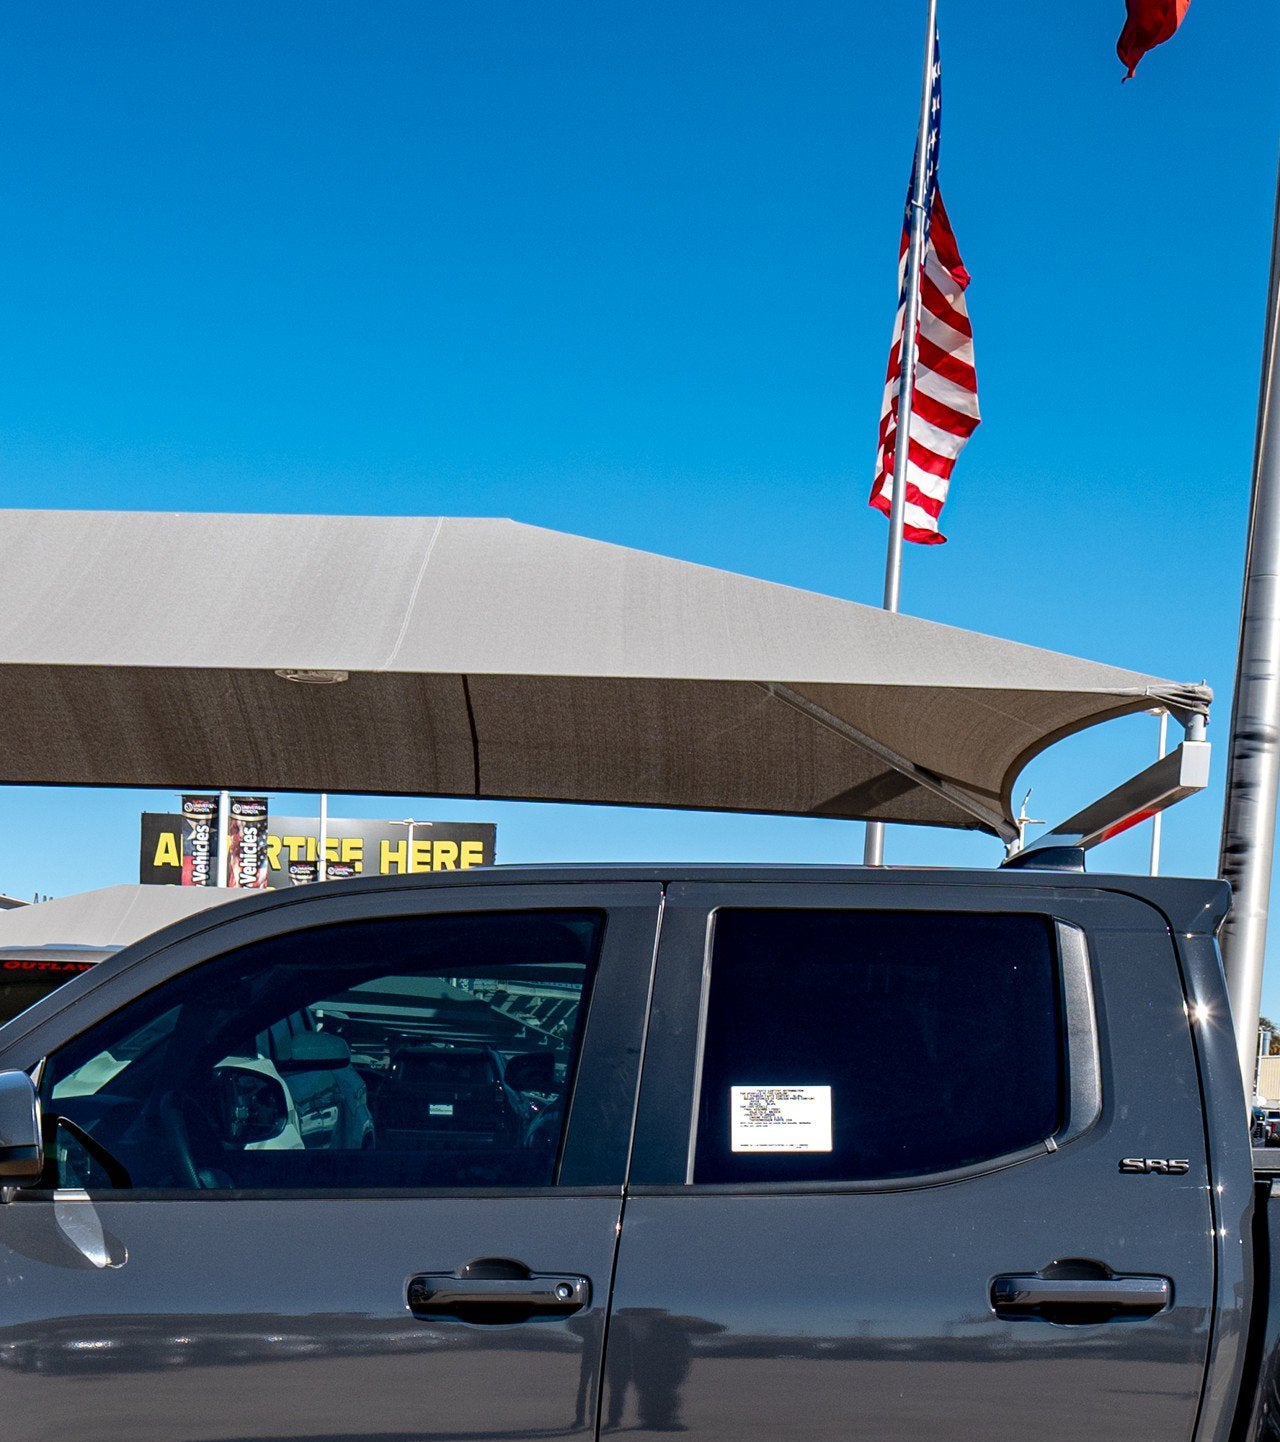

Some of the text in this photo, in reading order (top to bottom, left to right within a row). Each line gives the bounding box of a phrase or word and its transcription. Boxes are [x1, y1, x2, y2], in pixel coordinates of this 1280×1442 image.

[153, 832, 484, 875] ARTISE HERE
[192, 824, 210, 882] Vehicles
[239, 826, 258, 885] Vehicles
[1118, 1157, 1190, 1175] SR5
